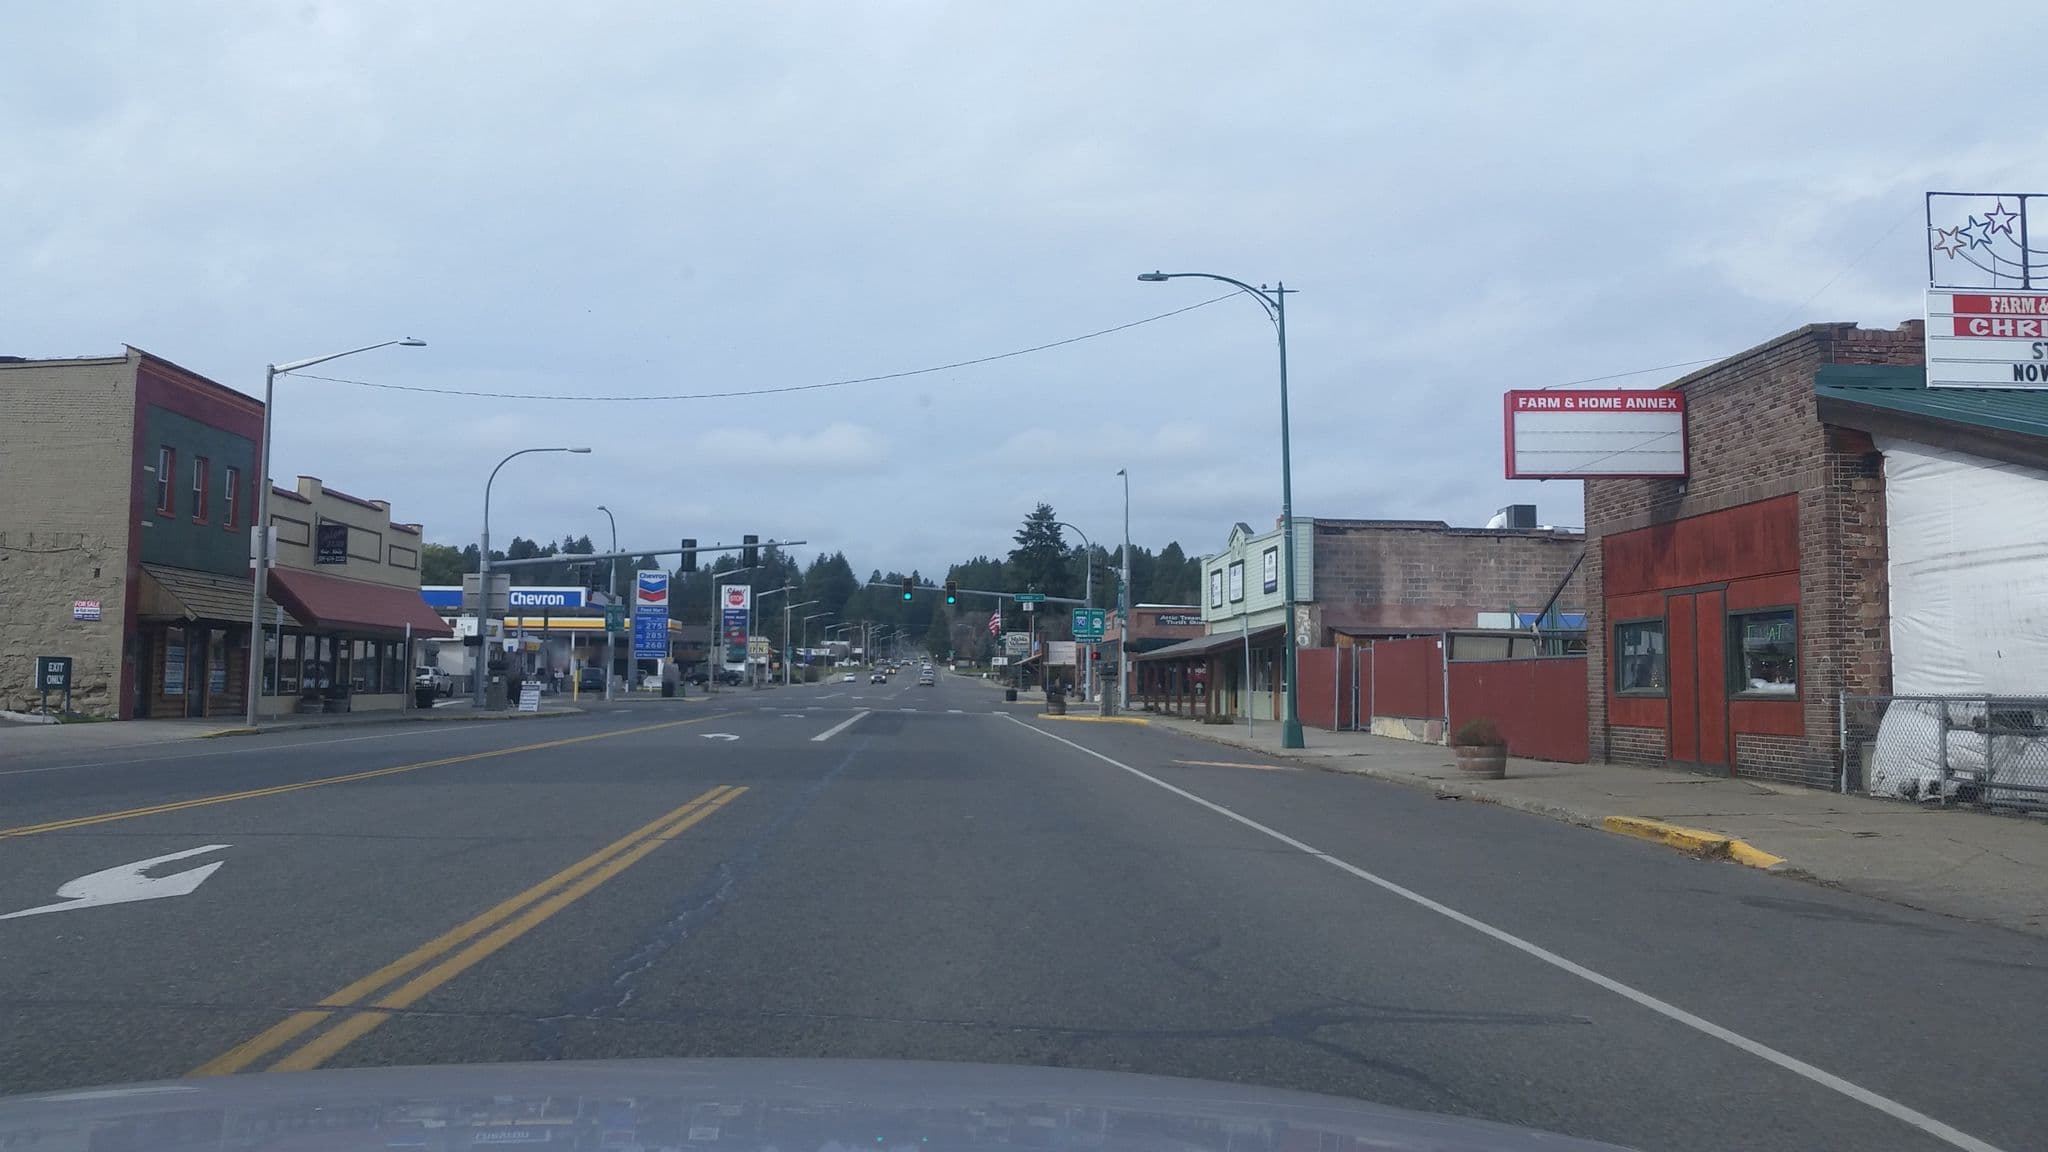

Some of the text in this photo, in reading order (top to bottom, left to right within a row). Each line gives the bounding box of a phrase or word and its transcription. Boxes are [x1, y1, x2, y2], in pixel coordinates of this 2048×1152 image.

[1990, 296, 2048, 314] FARM &
[1518, 398, 1677, 409] FARM & HOME ANNEX
[639, 572, 667, 580] Chevron
[510, 591, 565, 606] Chevron
[1076, 618, 1086, 626] 90
[48, 662, 65, 672] EXIT
[47, 675, 64, 684] ONLY
